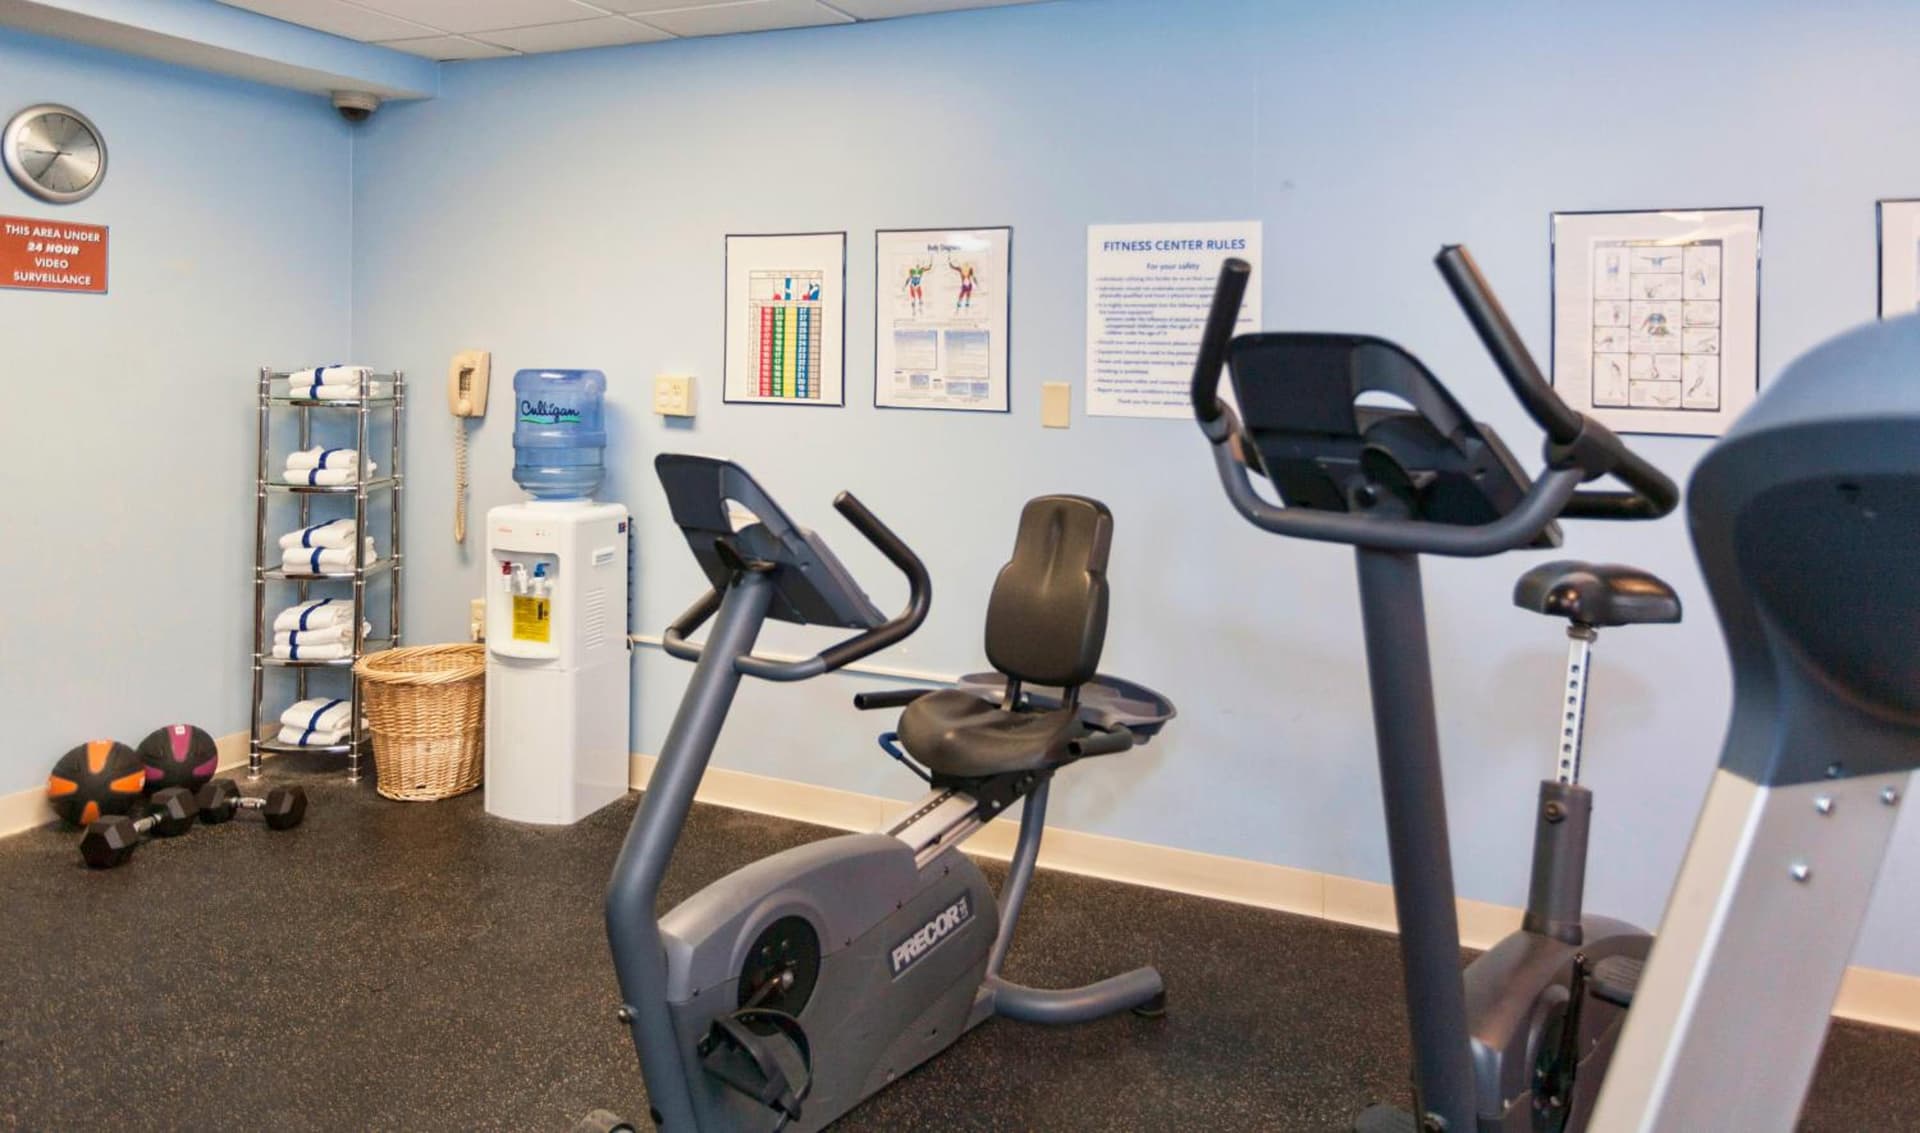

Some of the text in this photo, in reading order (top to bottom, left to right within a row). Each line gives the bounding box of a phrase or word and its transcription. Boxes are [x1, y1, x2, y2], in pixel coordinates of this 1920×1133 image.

[6, 224, 100, 242] THIS AREA UNDER
[27, 242, 79, 255] 24 HOUR
[1104, 239, 1246, 251] FITNESS CENTER RULES
[35, 257, 69, 269] VIDEO
[1146, 262, 1200, 271] For your safety
[14, 272, 91, 286] SURVEILLANCE
[521, 400, 580, 423] Culligan
[892, 904, 960, 972] PRECOR
